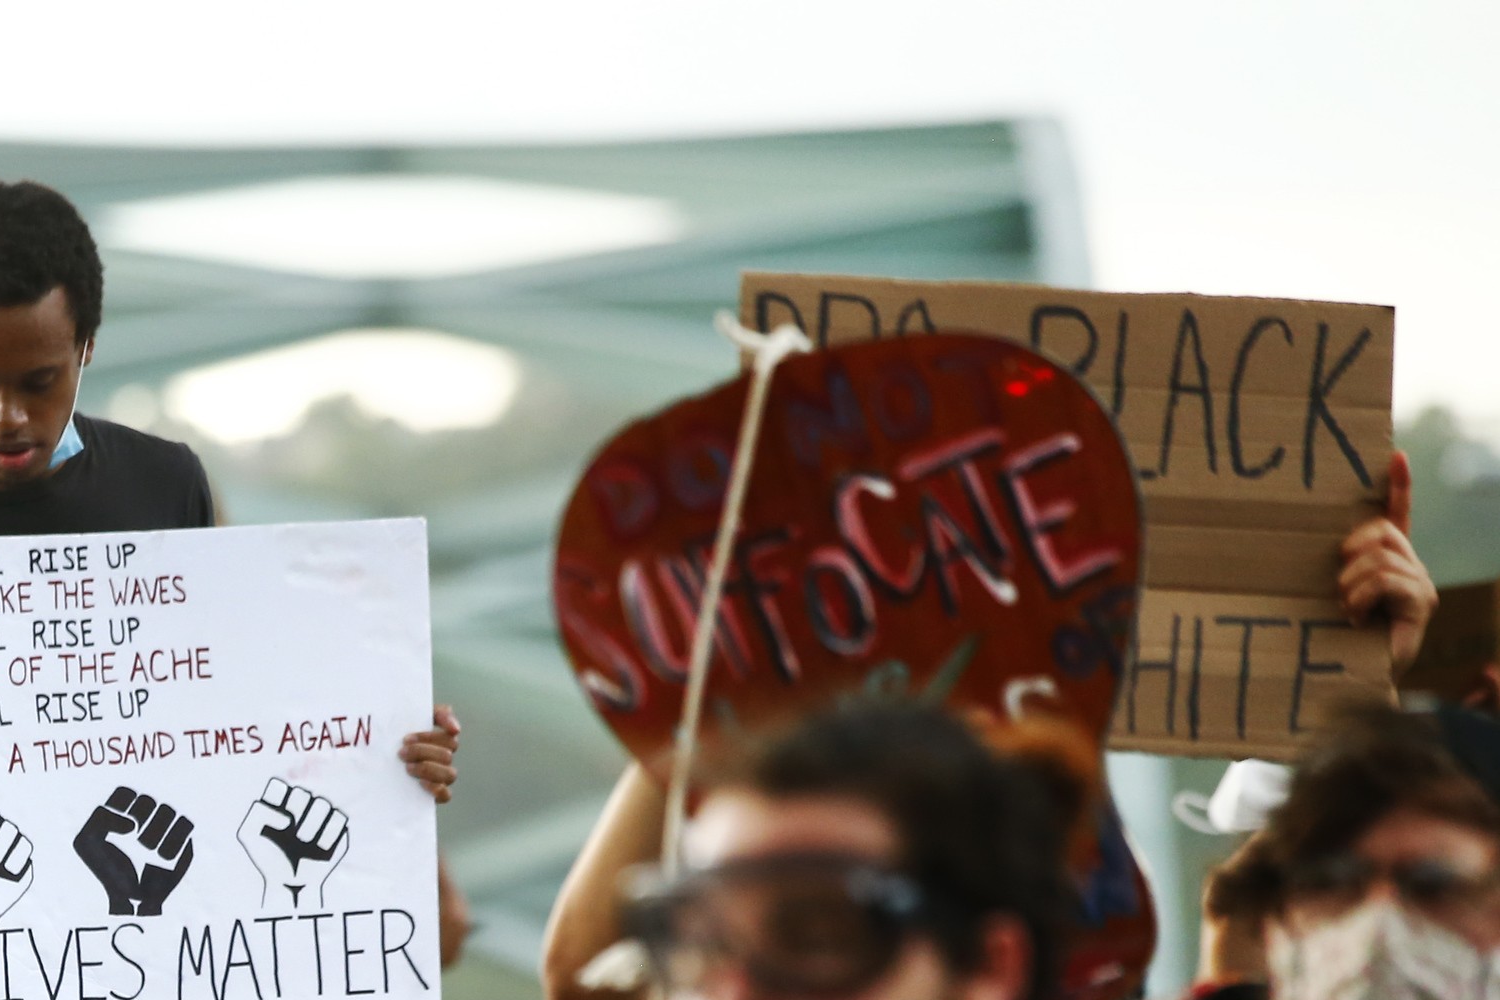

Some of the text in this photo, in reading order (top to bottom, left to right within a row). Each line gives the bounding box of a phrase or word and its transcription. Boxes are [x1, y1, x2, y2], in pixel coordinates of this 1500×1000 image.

[588, 427, 734, 539] DO
[28, 546, 89, 574] RISE
[106, 542, 137, 569] UP
[47, 578, 95, 610] THE
[109, 575, 187, 607] WAVES
[32, 618, 95, 650] RISE
[108, 616, 141, 646] UP
[8, 656, 43, 686] OF
[58, 651, 118, 685] THE
[129, 647, 213, 684] ACHE
[1127, 613, 1353, 741] HITE
[35, 690, 103, 724] RISE
[117, 688, 150, 720] UP
[8, 742, 26, 774] A
[33, 730, 176, 772] THOUSAND
[183, 724, 265, 759] TIMES
[277, 714, 372, 755] AGAIN
